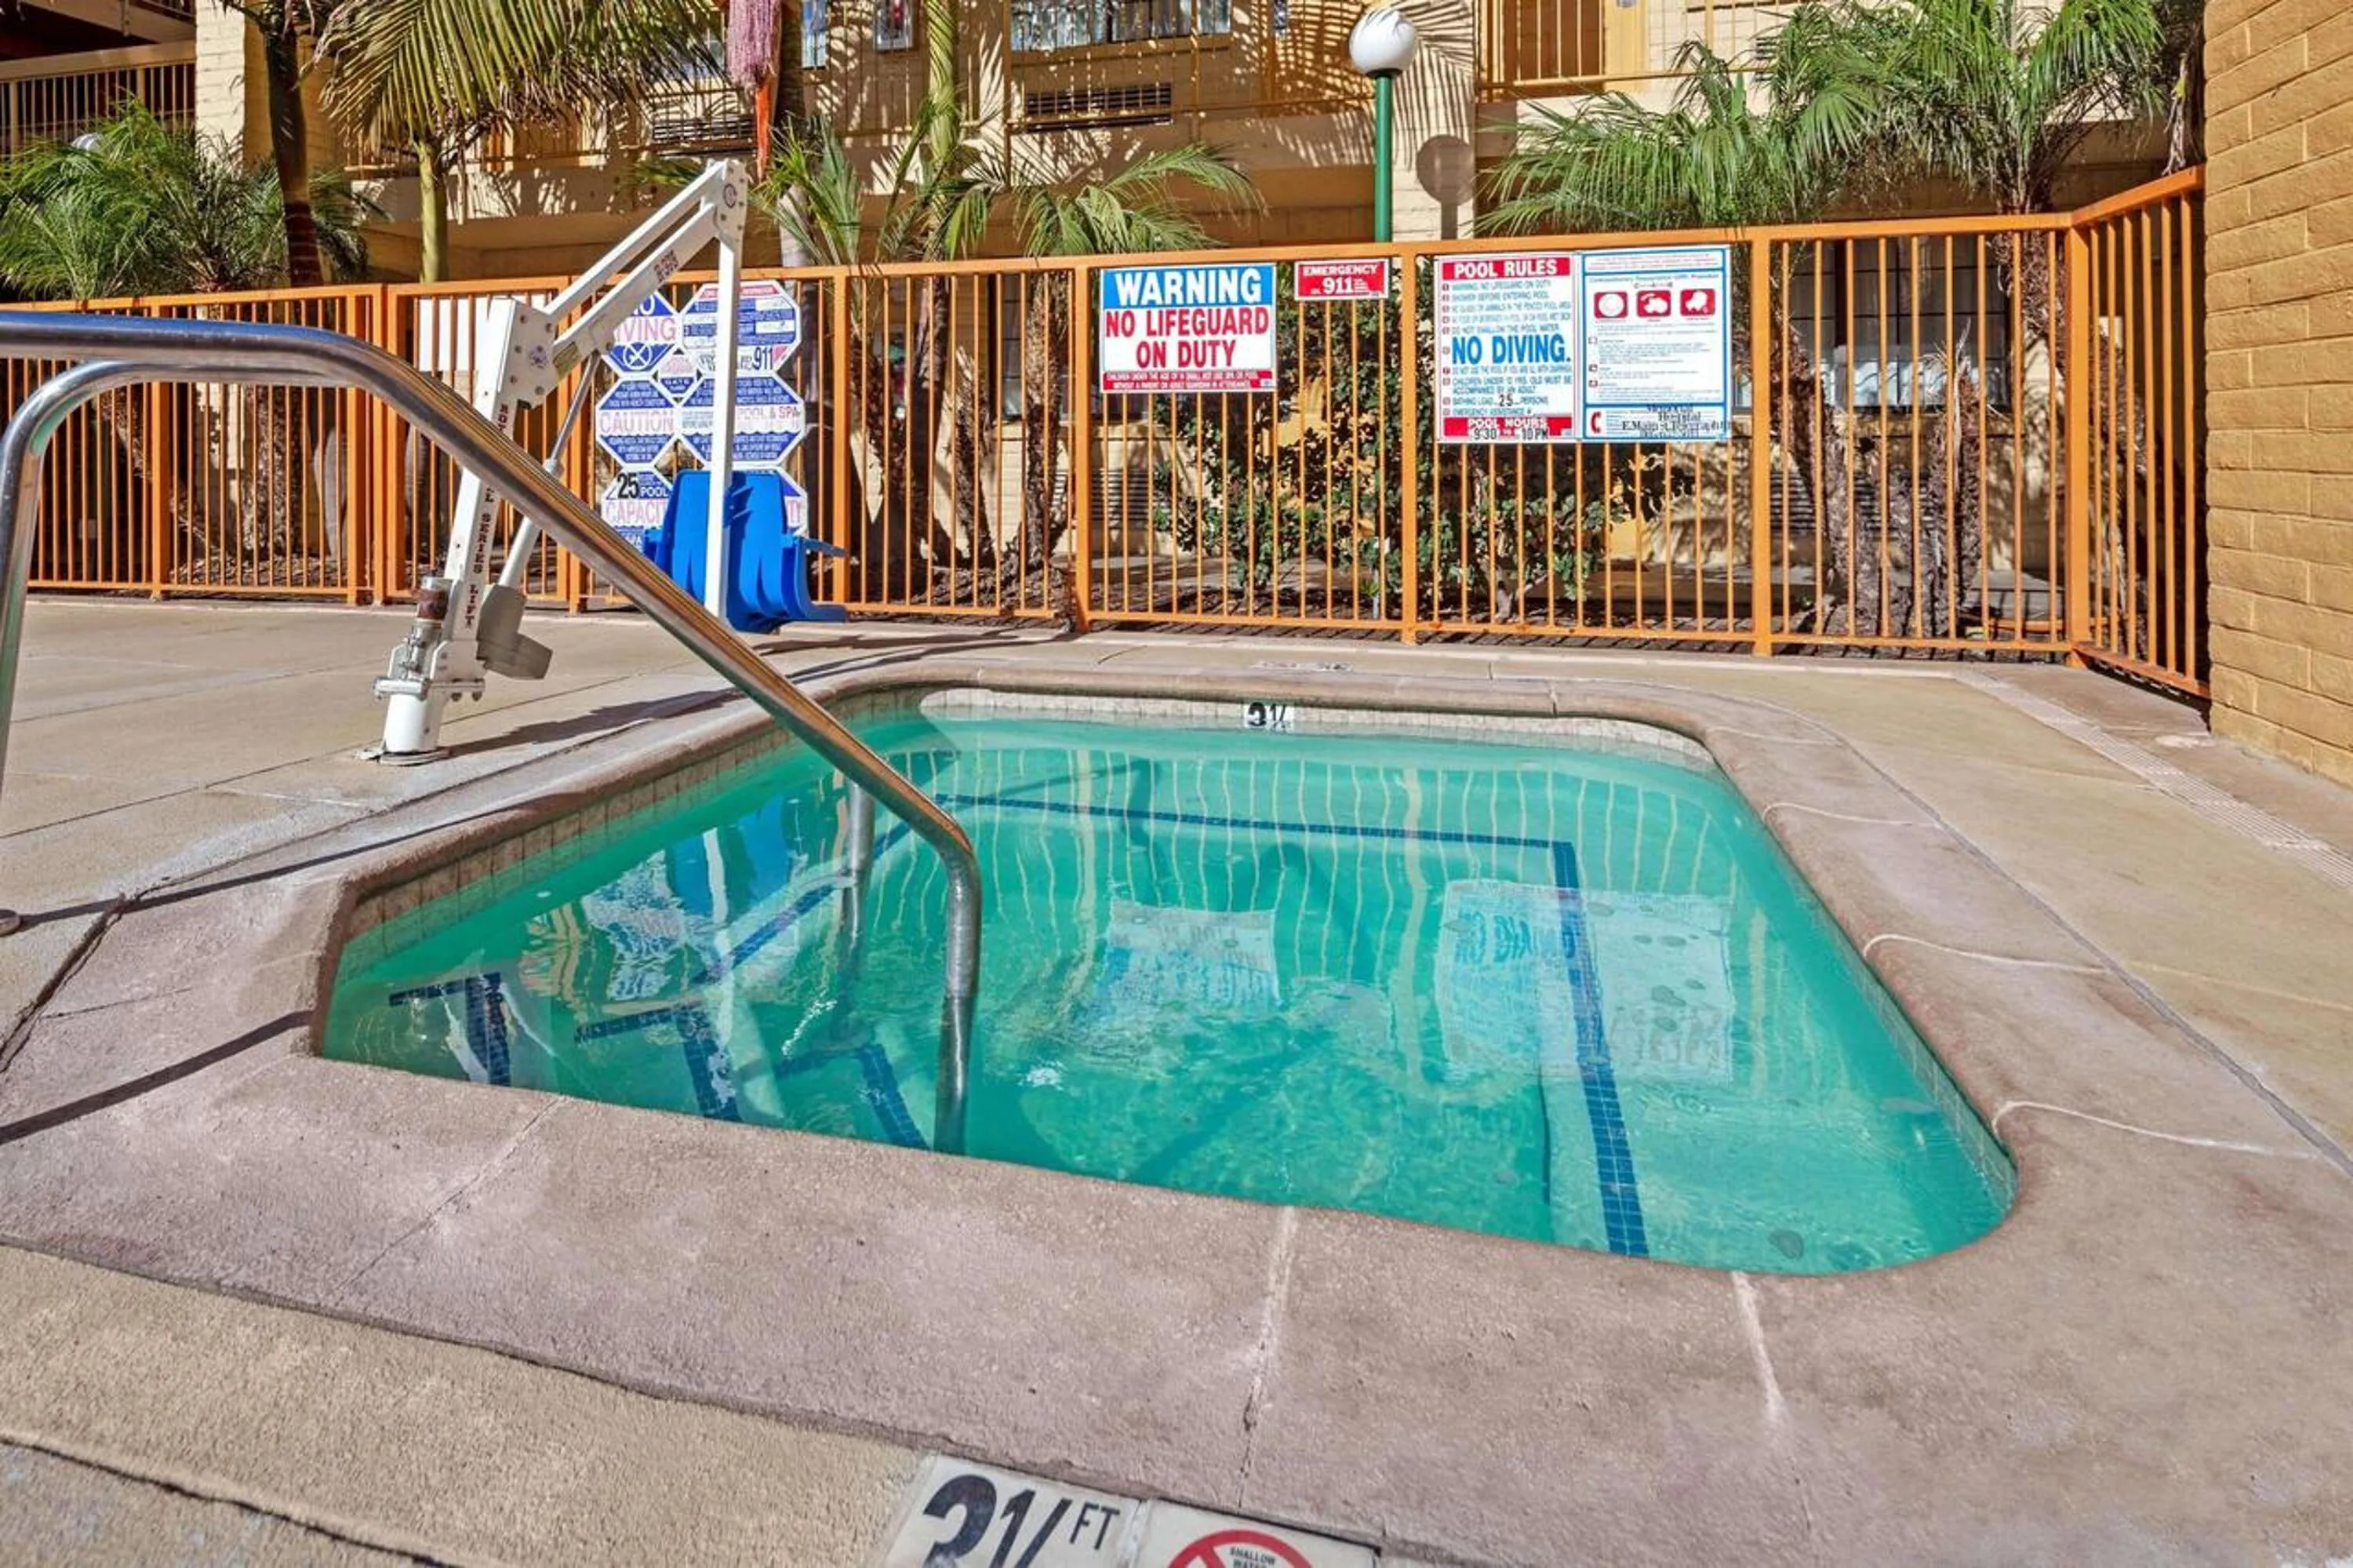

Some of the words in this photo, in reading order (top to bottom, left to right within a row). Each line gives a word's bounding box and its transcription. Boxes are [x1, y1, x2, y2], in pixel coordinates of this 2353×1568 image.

[1303, 264, 1378, 276] EMERGENCY
[1454, 263, 1498, 278] POOL
[1504, 260, 1558, 276] RULES
[1115, 270, 1262, 306] WARNING
[1322, 277, 1354, 294] 911
[1105, 309, 1136, 337] NO
[1146, 307, 1270, 337] LIFEGUARD
[752, 347, 773, 370] 911
[1136, 340, 1166, 369] ON
[1177, 340, 1237, 368] DUTY
[1452, 336, 1482, 364] NO
[1492, 333, 1571, 363] DIVING.
[1498, 394, 1514, 407] 25
[599, 410, 674, 433] CAUTION
[1467, 418, 1501, 428] POOL
[1504, 417, 1548, 427] HOURS
[617, 472, 639, 499] 25
[640, 486, 668, 497] POOL
[473, 513, 492, 573] SERIES
[465, 584, 478, 626] LIFT
[1069, 1501, 1121, 1551] FT
